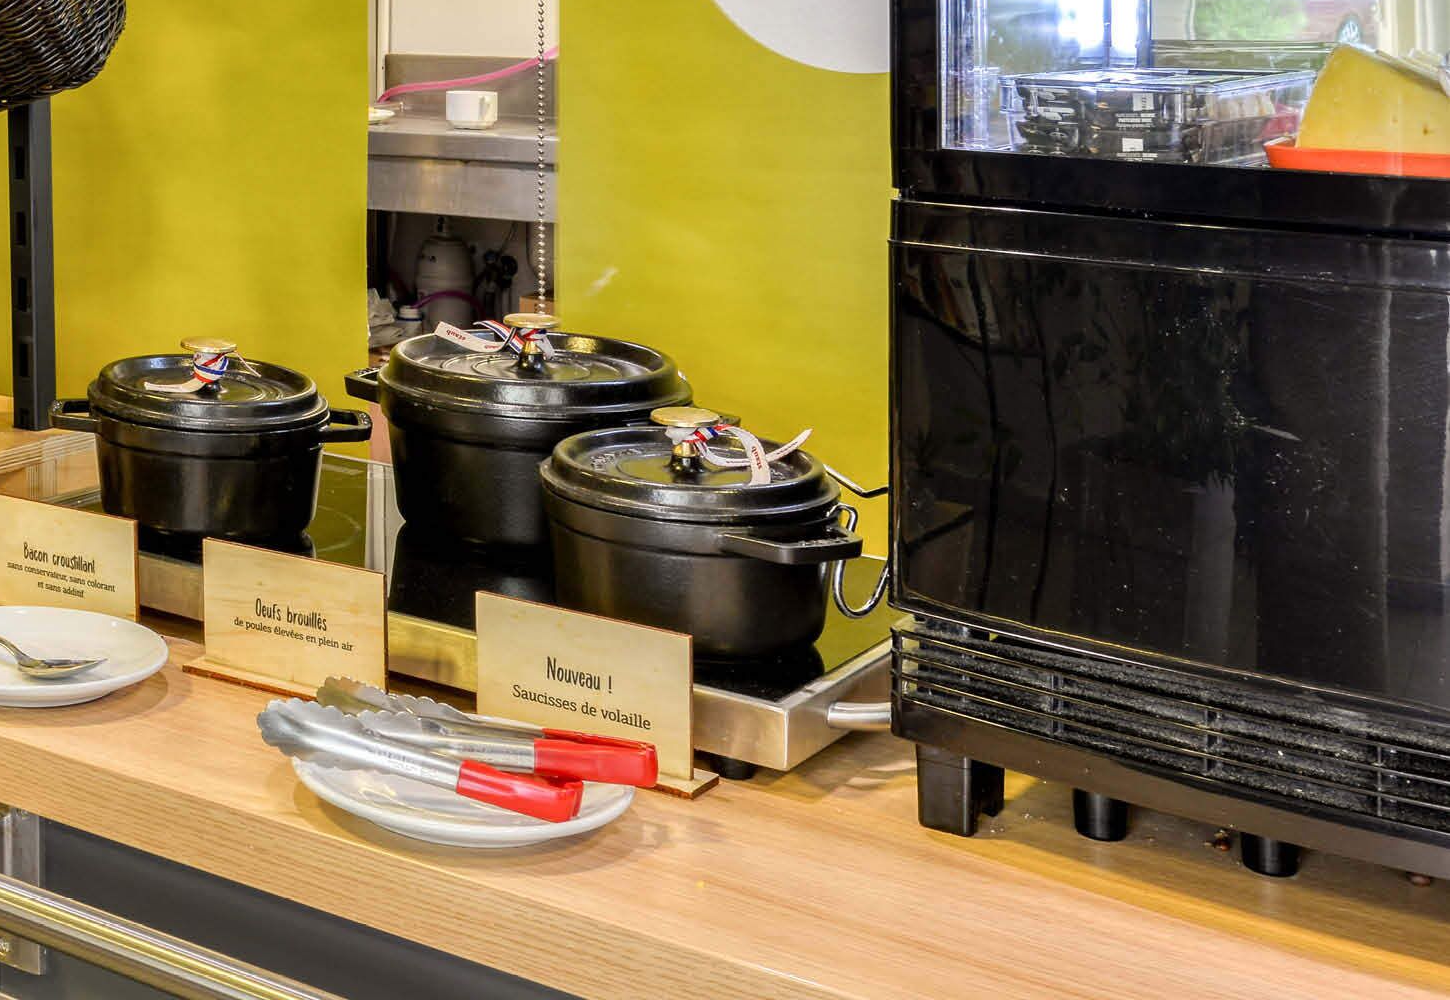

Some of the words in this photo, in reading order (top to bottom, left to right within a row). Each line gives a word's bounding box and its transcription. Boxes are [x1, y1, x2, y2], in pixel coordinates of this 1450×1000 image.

[23, 541, 48, 563] Bacon
[52, 552, 95, 574] croustillant
[6, 561, 23, 571] sans
[24, 566, 69, 583] conservateur,
[69, 576, 86, 586] sans
[87, 579, 116, 592] colorant
[37, 581, 45, 589] et
[45, 583, 62, 593] sans
[255, 597, 281, 622] Oeufs
[286, 605, 327, 632] brouillés
[233, 617, 244, 627] de
[245, 619, 272, 634] poules
[273, 625, 304, 641] élevées
[305, 635, 317, 644] en
[318, 635, 340, 650] plein
[341, 641, 354, 652] air
[546, 656, 601, 691] Nouveau
[608, 675, 613, 694] !
[512, 684, 578, 712] Saucisses
[580, 701, 597, 717] de
[601, 708, 651, 730] volaille
